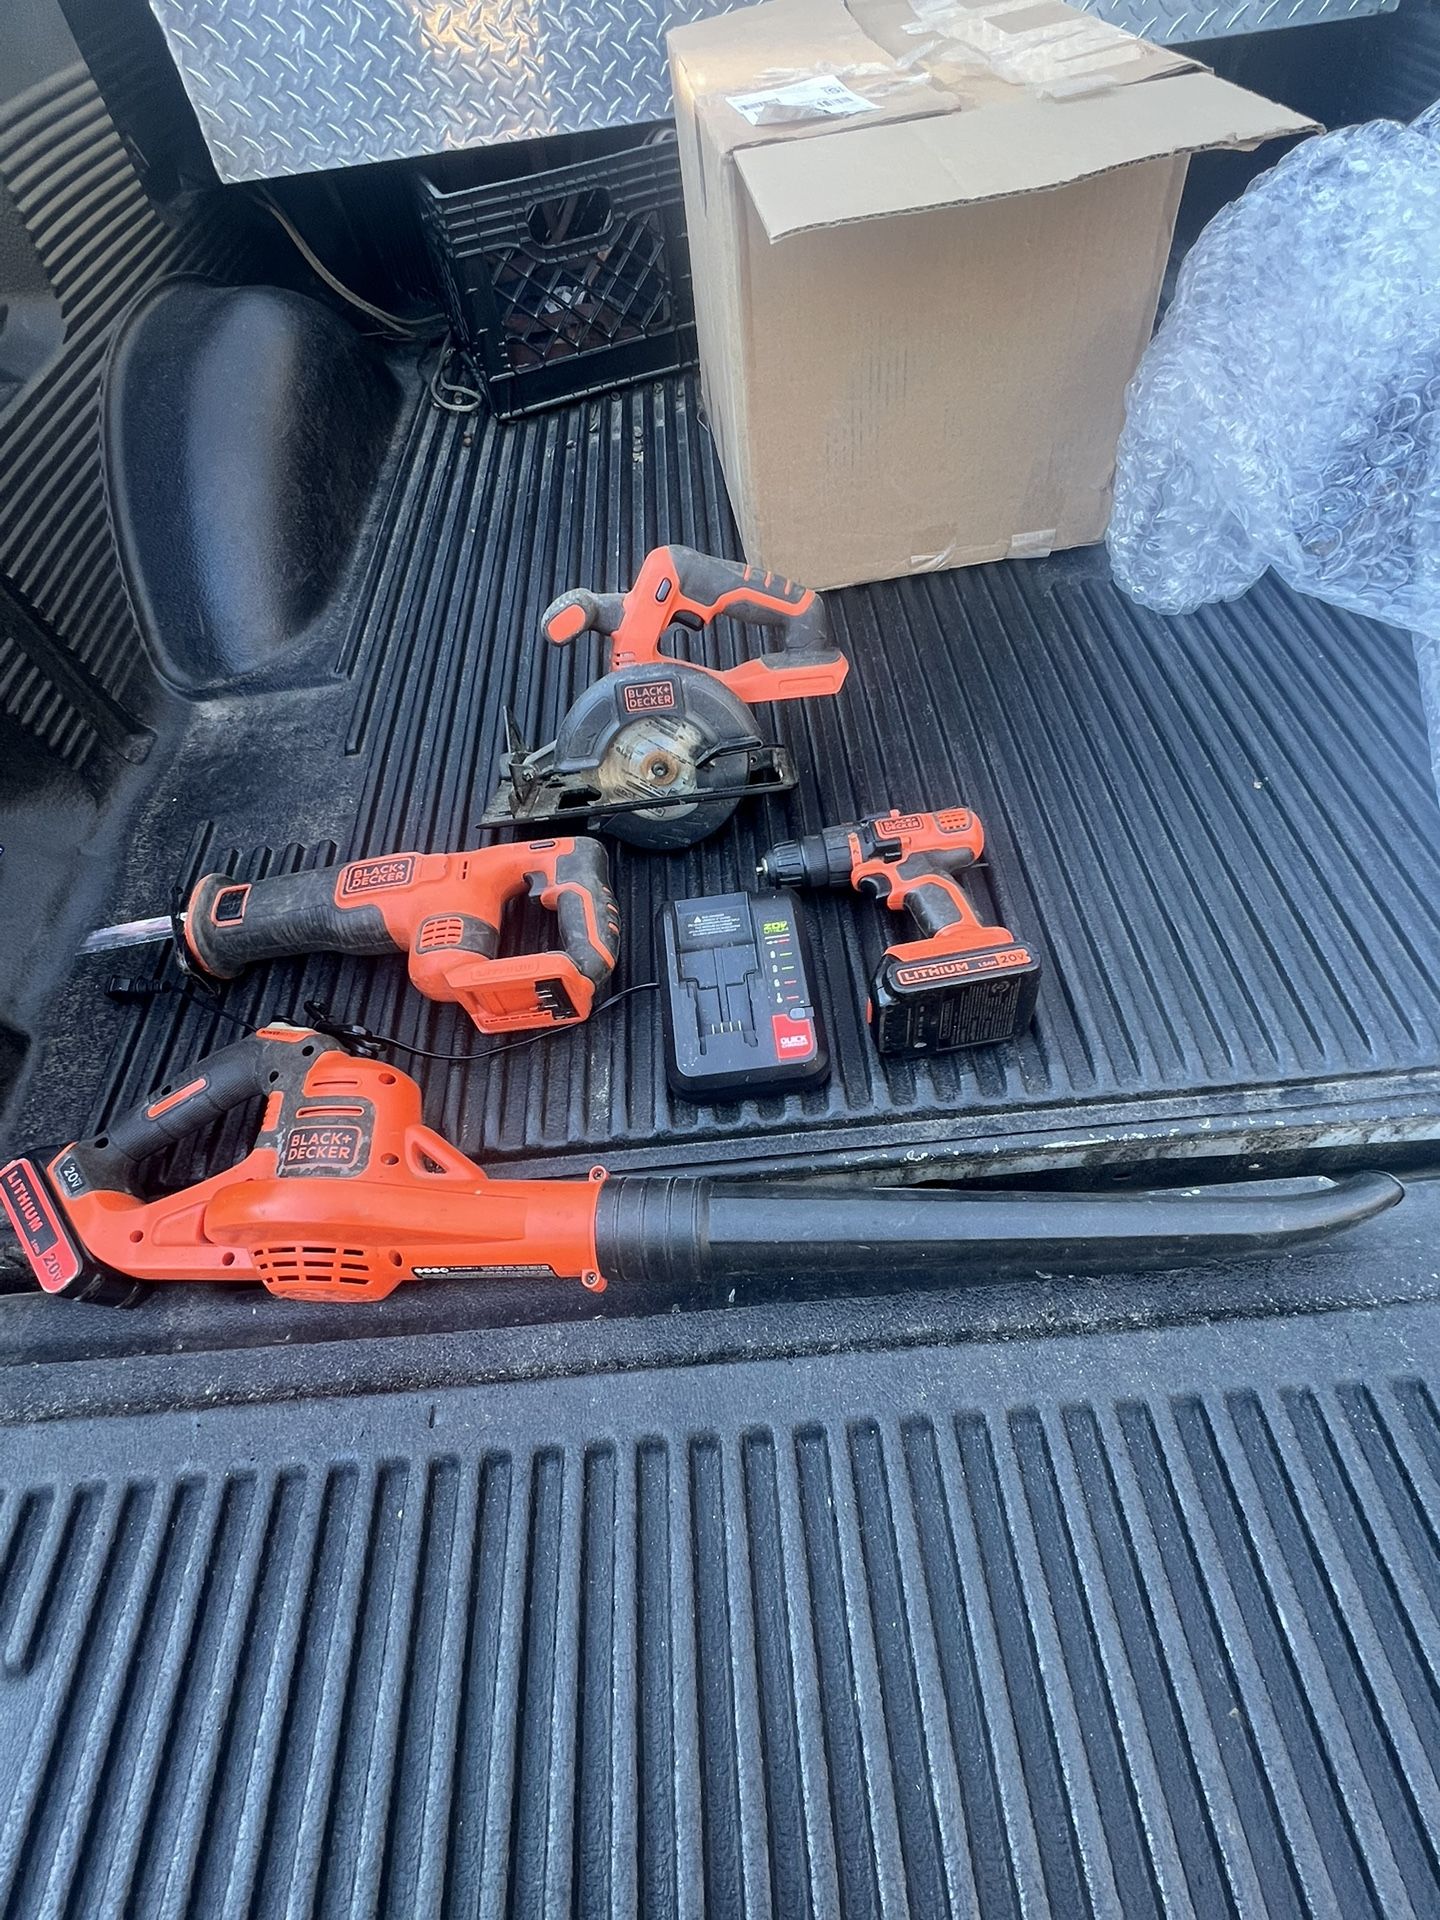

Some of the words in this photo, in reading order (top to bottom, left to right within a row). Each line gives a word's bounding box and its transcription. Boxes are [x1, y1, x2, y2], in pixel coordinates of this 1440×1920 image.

[628, 686, 669, 698] BLACK+
[630, 695, 671, 707] DECKER
[354, 863, 405, 878] BLACK+
[352, 871, 404, 887] DECKER
[904, 962, 968, 981] LITHIUM
[1000, 953, 1023, 963] 20V
[291, 1132, 352, 1146] BLACK+
[288, 1147, 350, 1161] DECKER
[64, 1165, 82, 1188] 20V
[7, 1171, 43, 1232] LITHIUM
[43, 1253, 63, 1282] 20V
